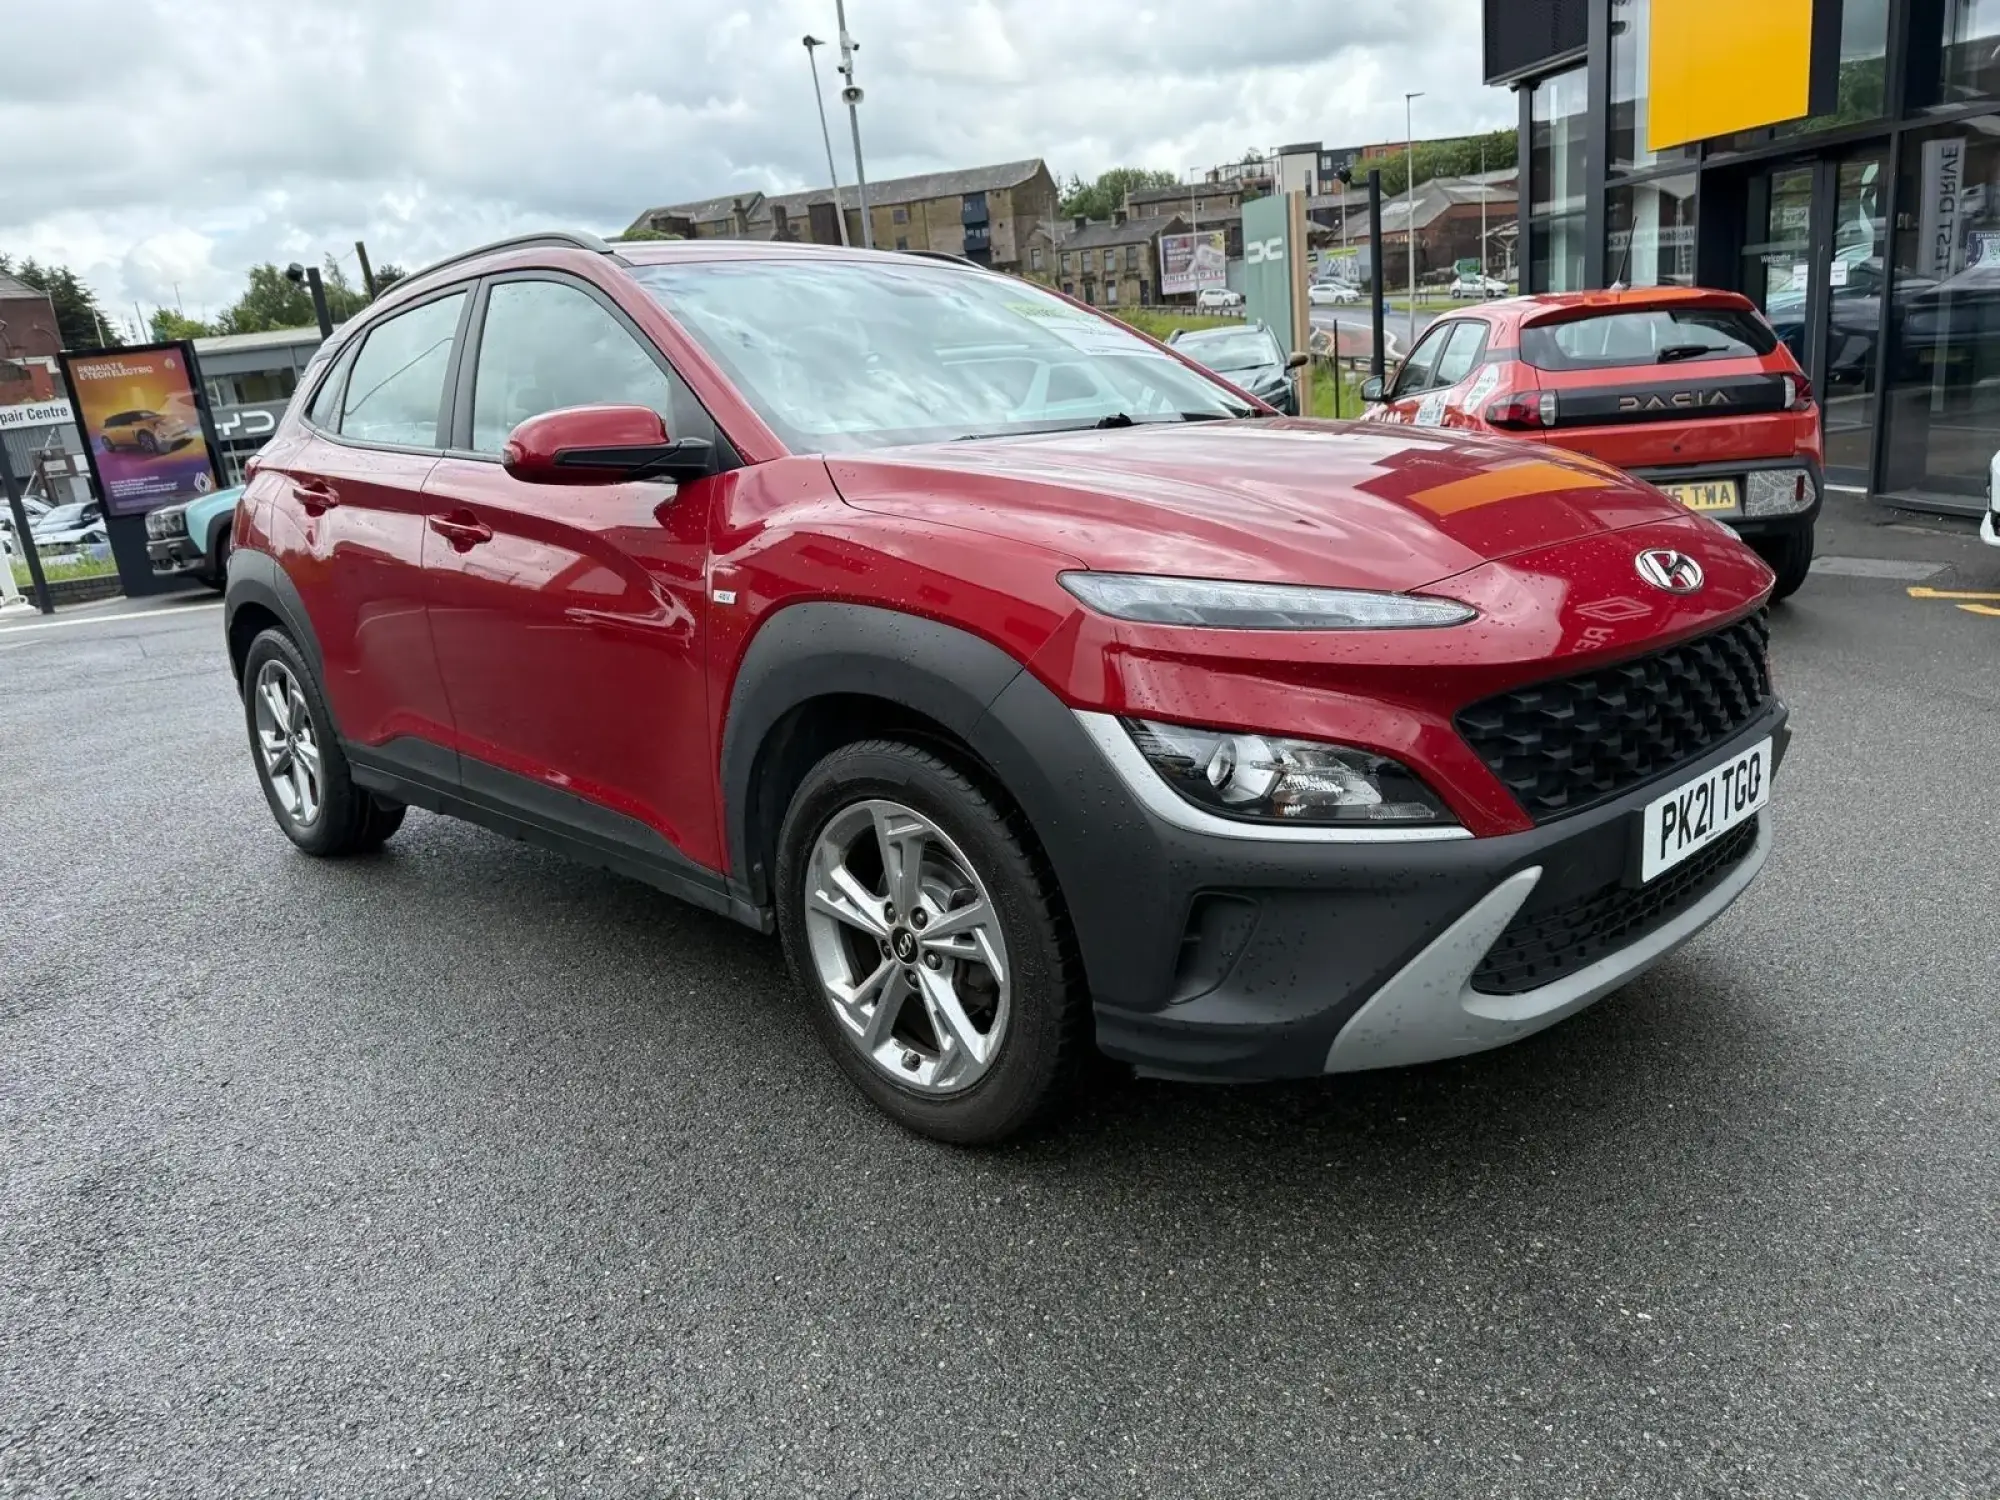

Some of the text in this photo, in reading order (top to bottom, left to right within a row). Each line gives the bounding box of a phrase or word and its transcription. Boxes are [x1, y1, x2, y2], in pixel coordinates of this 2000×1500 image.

[1760, 254, 1791, 263] Welcome
[77, 362, 117, 373] RENAULT
[112, 365, 154, 378] ELECTRIC
[1619, 389, 1732, 412] DACIA
[0, 406, 68, 425] pair Centre
[215, 410, 275, 436] YD
[1690, 484, 1731, 505] TWA
[1660, 751, 1761, 861] PK21 TGO
